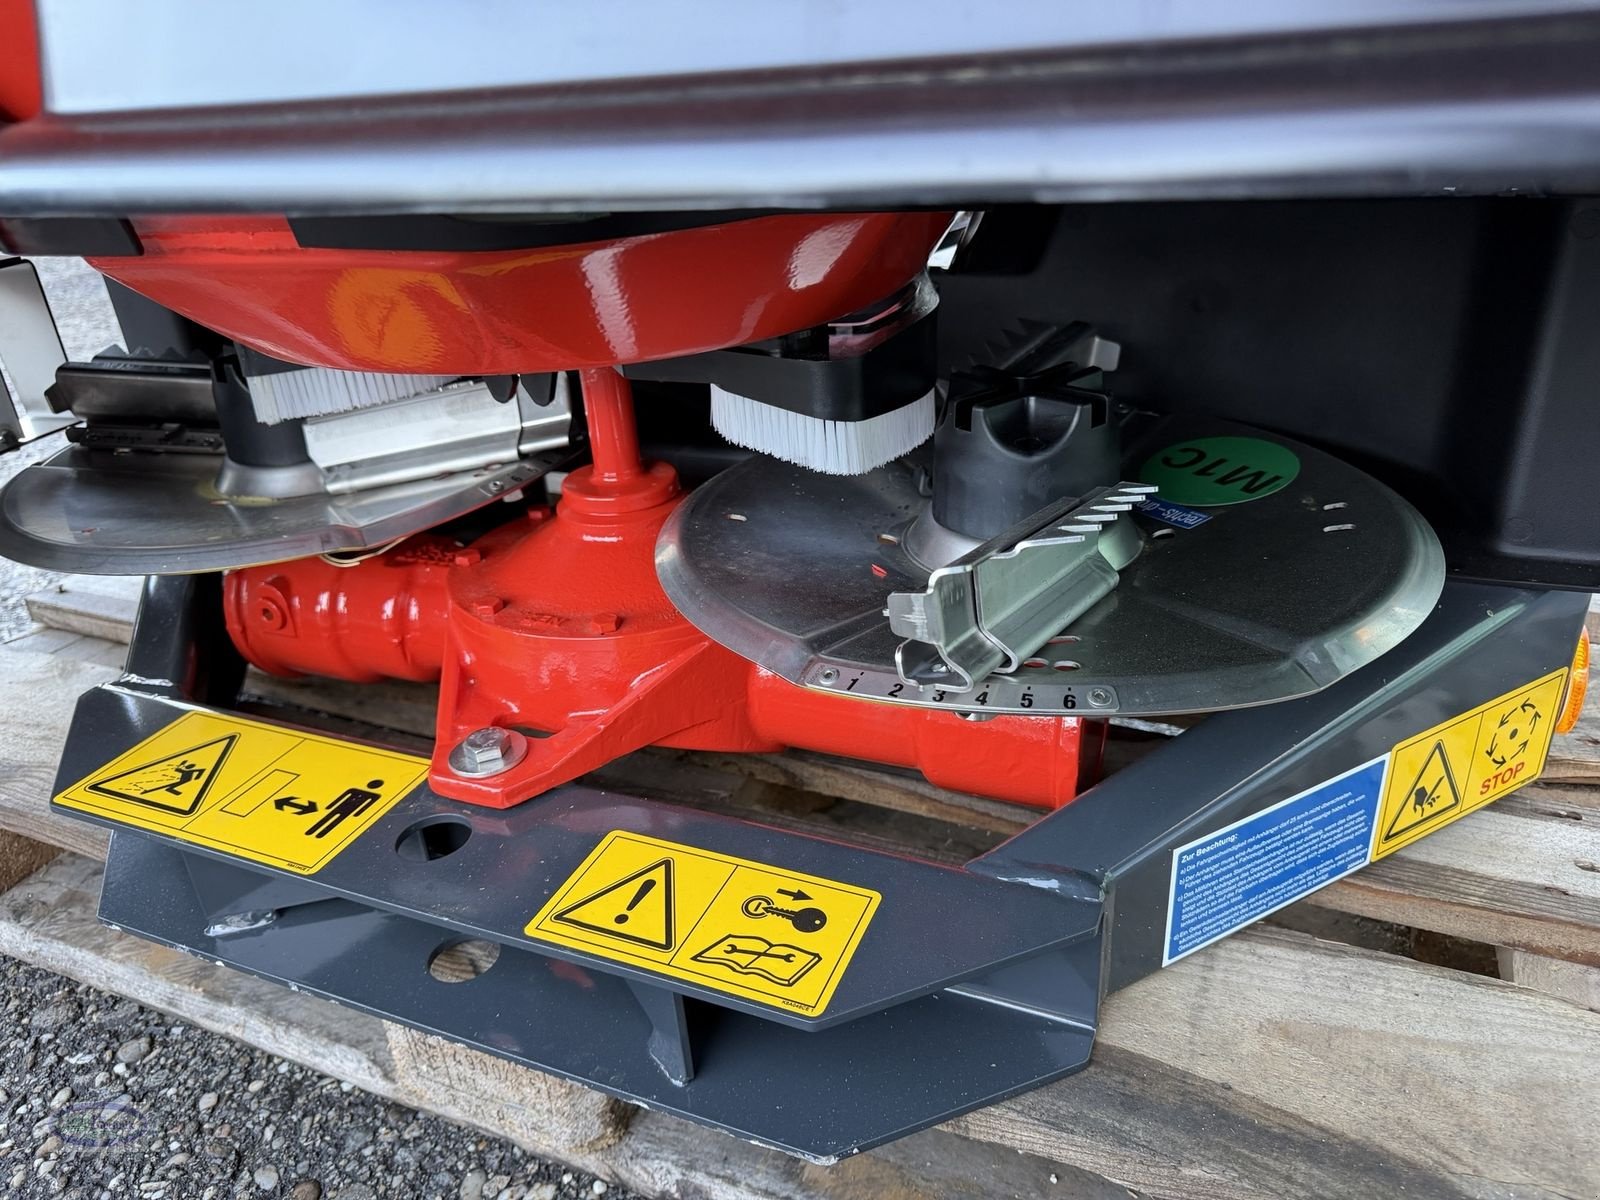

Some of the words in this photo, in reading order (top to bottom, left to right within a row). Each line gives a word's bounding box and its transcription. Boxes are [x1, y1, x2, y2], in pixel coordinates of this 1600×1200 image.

[1162, 447, 1284, 494] M1C
[846, 678, 859, 691] 1
[888, 684, 903, 697] 2
[932, 690, 946, 703] 3
[975, 691, 989, 705] 4
[1020, 693, 1034, 708] 5
[1063, 694, 1077, 709] 6
[1480, 761, 1525, 796] STOP
